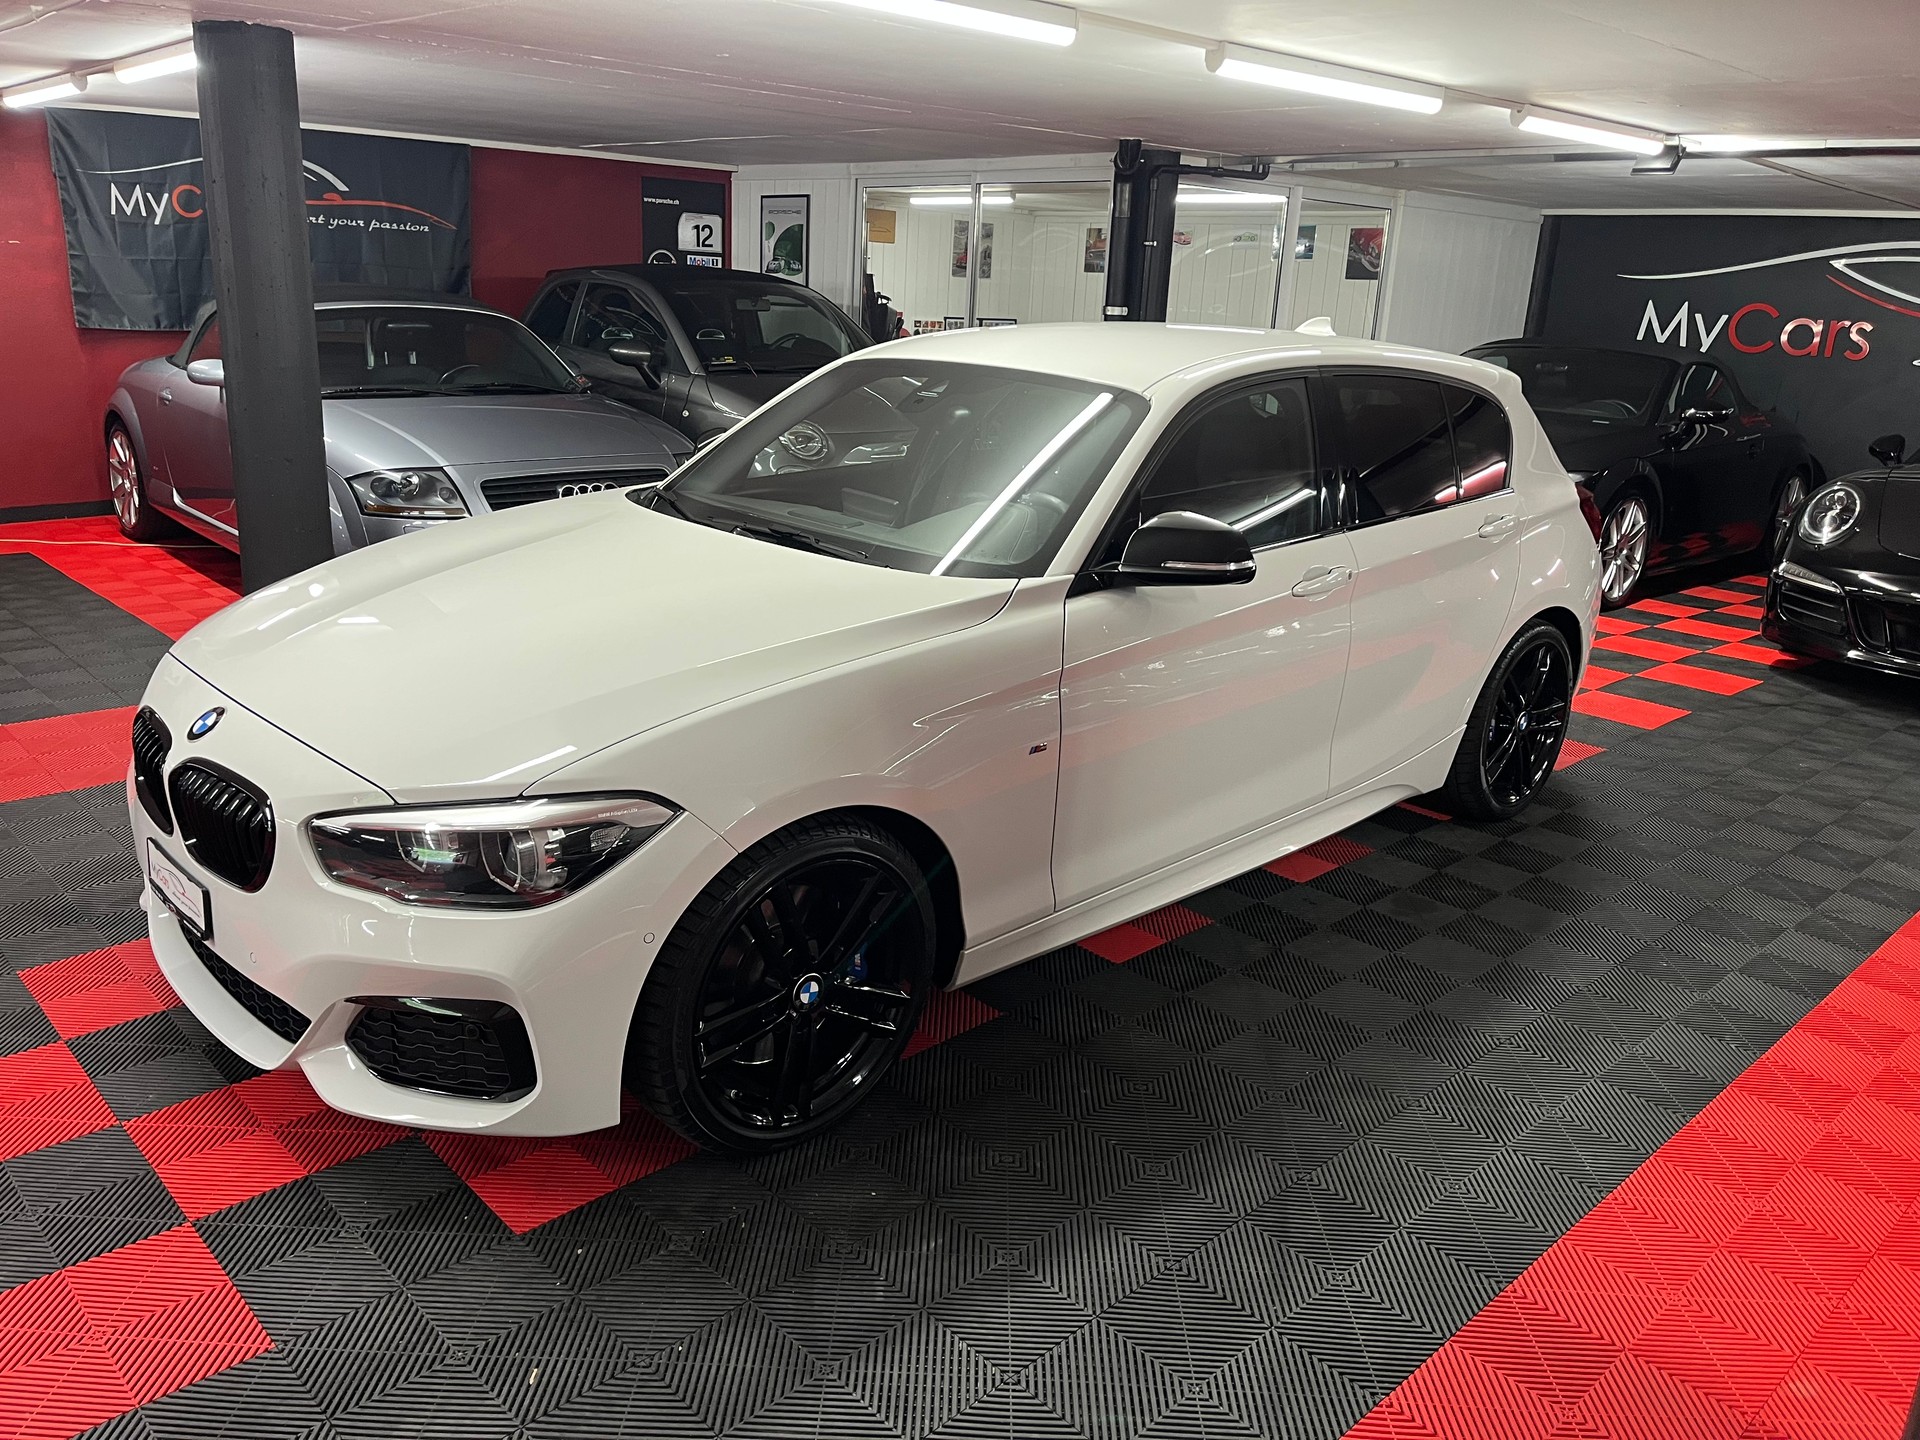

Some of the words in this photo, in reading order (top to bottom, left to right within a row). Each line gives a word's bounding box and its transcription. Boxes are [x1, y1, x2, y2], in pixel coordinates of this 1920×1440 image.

[643, 196, 680, 205] www.porsche.ch
[328, 216, 365, 229] your
[369, 218, 430, 232] passion
[691, 224, 714, 248] 12
[689, 256, 711, 267] Mobil
[1635, 299, 1876, 361] MyCars
